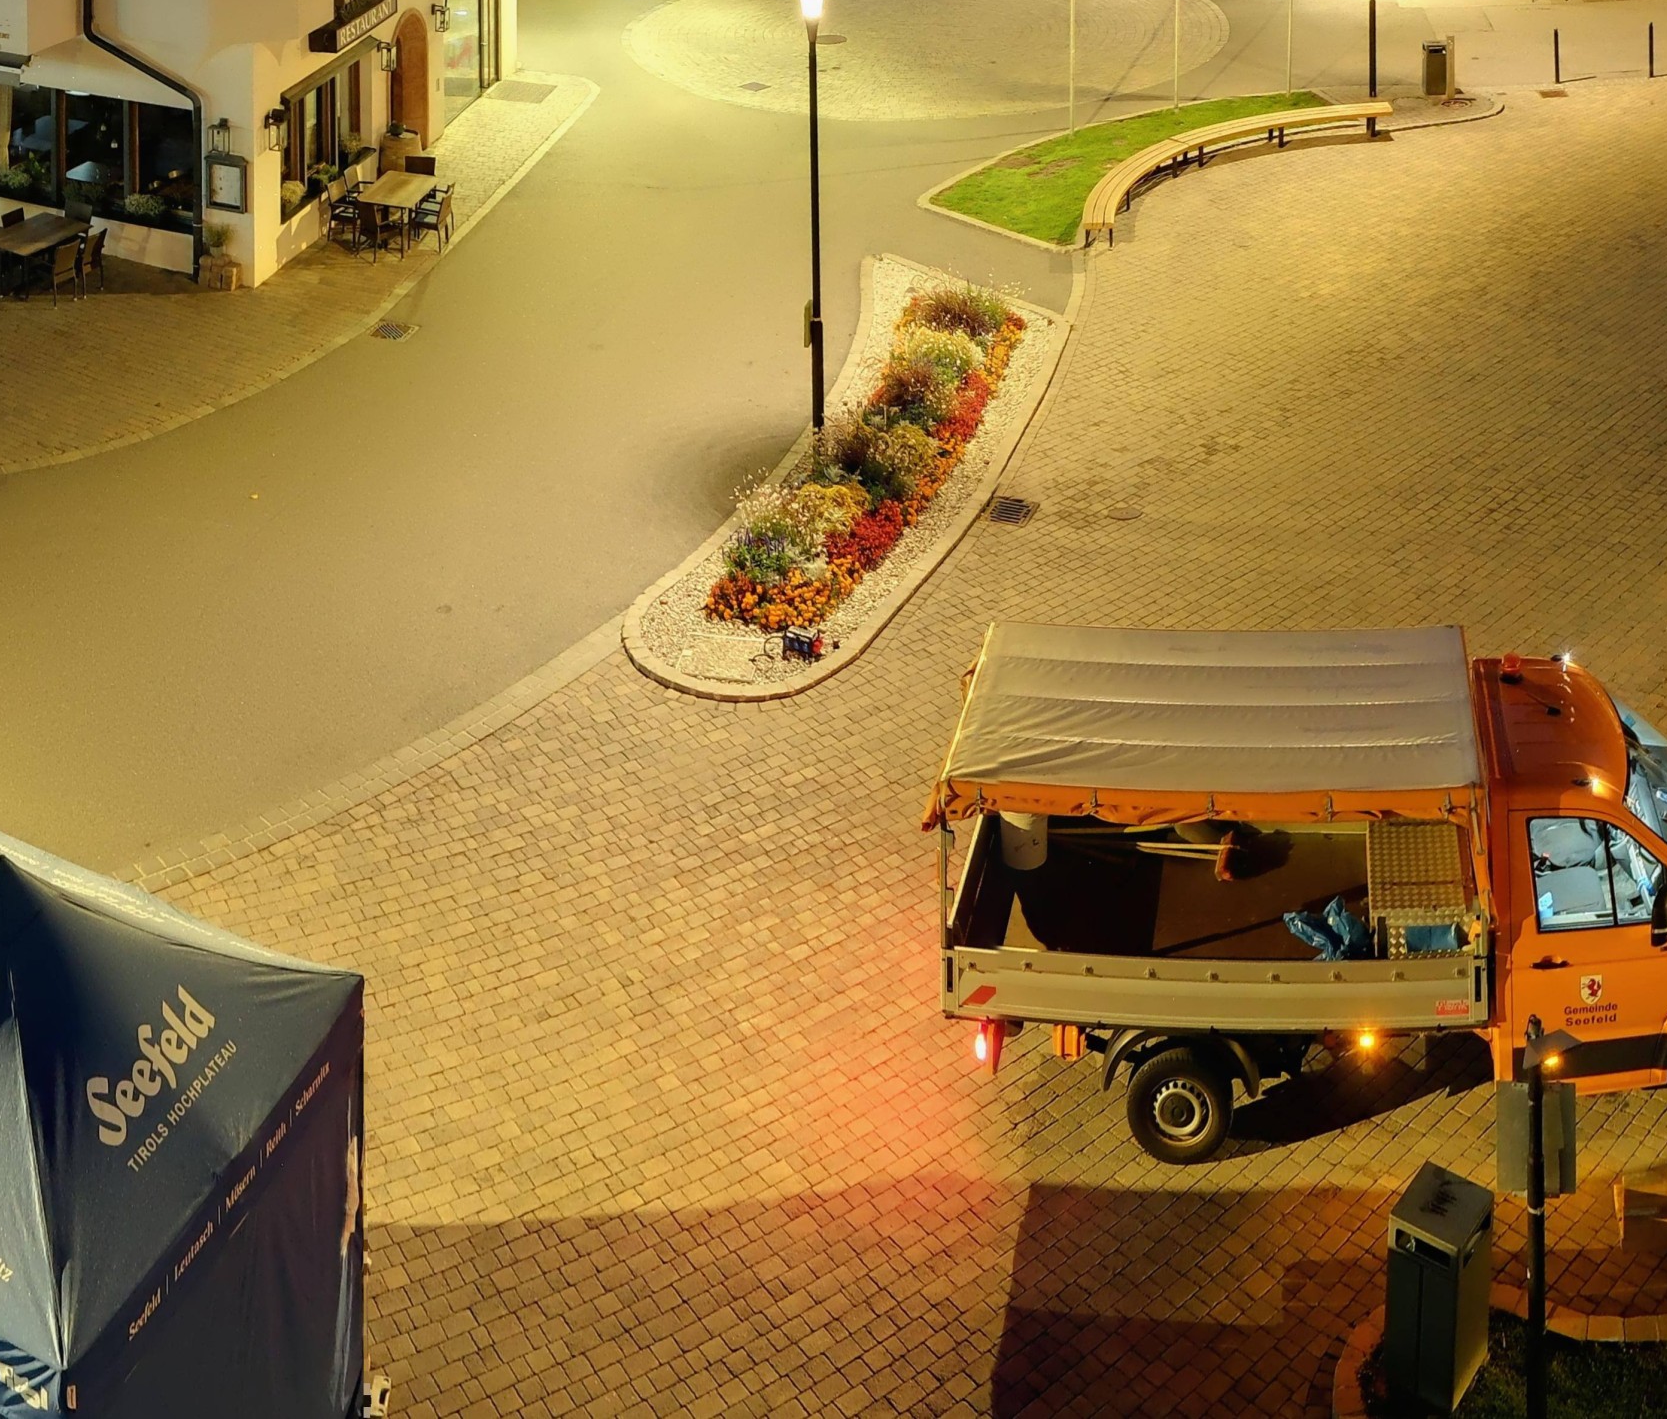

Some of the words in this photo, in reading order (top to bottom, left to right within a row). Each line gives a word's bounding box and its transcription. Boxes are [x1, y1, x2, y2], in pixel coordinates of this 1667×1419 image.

[86, 984, 216, 1147] Seefeld
[1564, 1002, 1619, 1016] Gemeinde
[1564, 1013, 1618, 1028] Seefeld
[127, 1123, 169, 1173] TIROLS
[166, 1039, 238, 1129] HOCHPLATEAU
[128, 1287, 162, 1342] Seefeld
[174, 1220, 214, 1282] Leutasch
[224, 1164, 257, 1213] Mösern
[265, 1121, 288, 1159] Reith
[295, 1061, 332, 1117] Scharnitz
